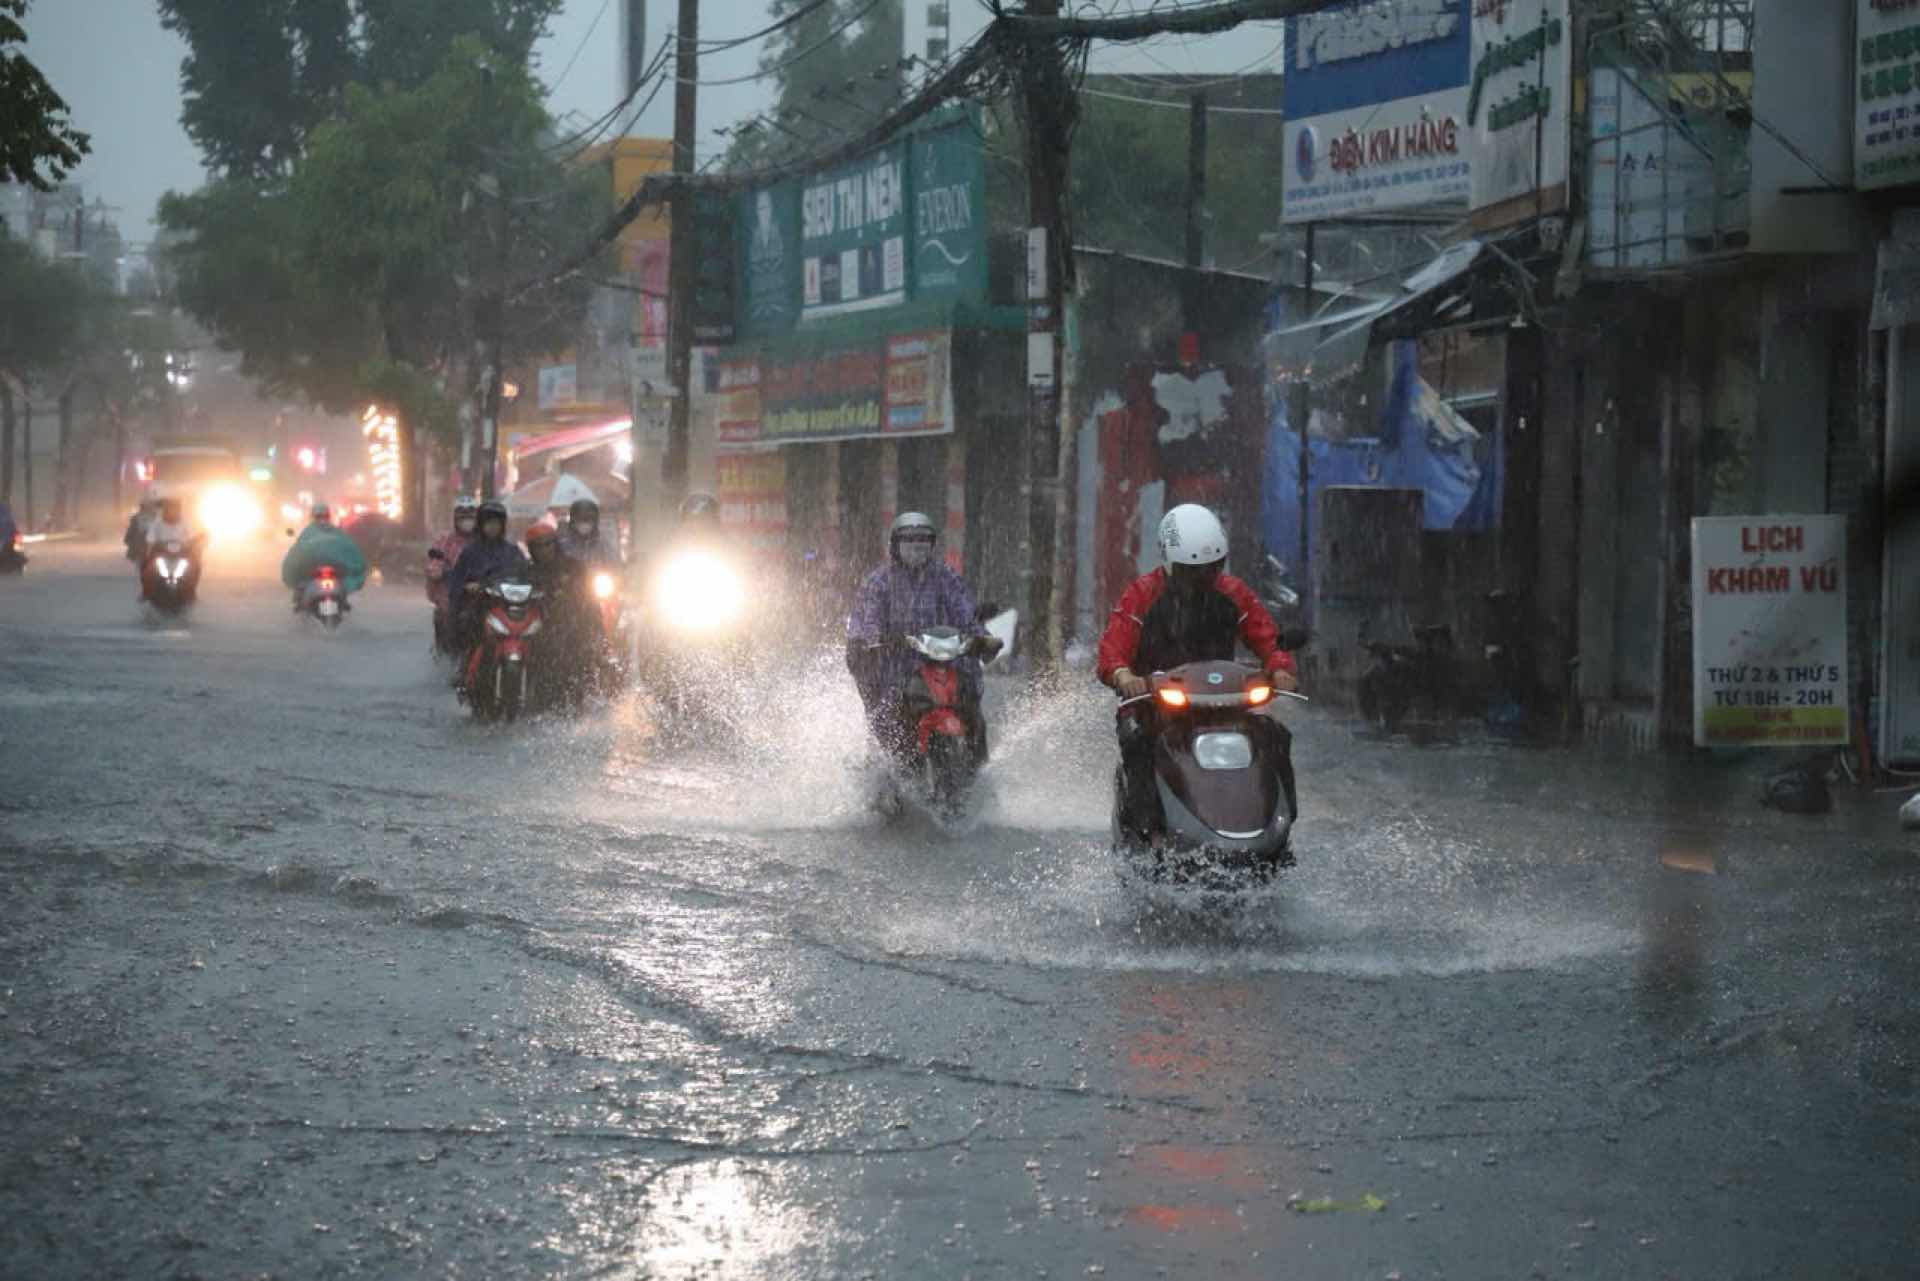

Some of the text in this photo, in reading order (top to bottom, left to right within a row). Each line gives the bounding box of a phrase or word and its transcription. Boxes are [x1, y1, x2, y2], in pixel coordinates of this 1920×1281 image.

[1368, 127, 1399, 164] KIM
[917, 181, 972, 236] EVERON
[1742, 526, 1803, 557] LỊCH
[1707, 556, 1790, 593] KHÁM
[1751, 666, 1762, 682] 2
[1767, 666, 1779, 682] &
[1827, 666, 1838, 682] 5
[1797, 690, 1833, 705] 20H
